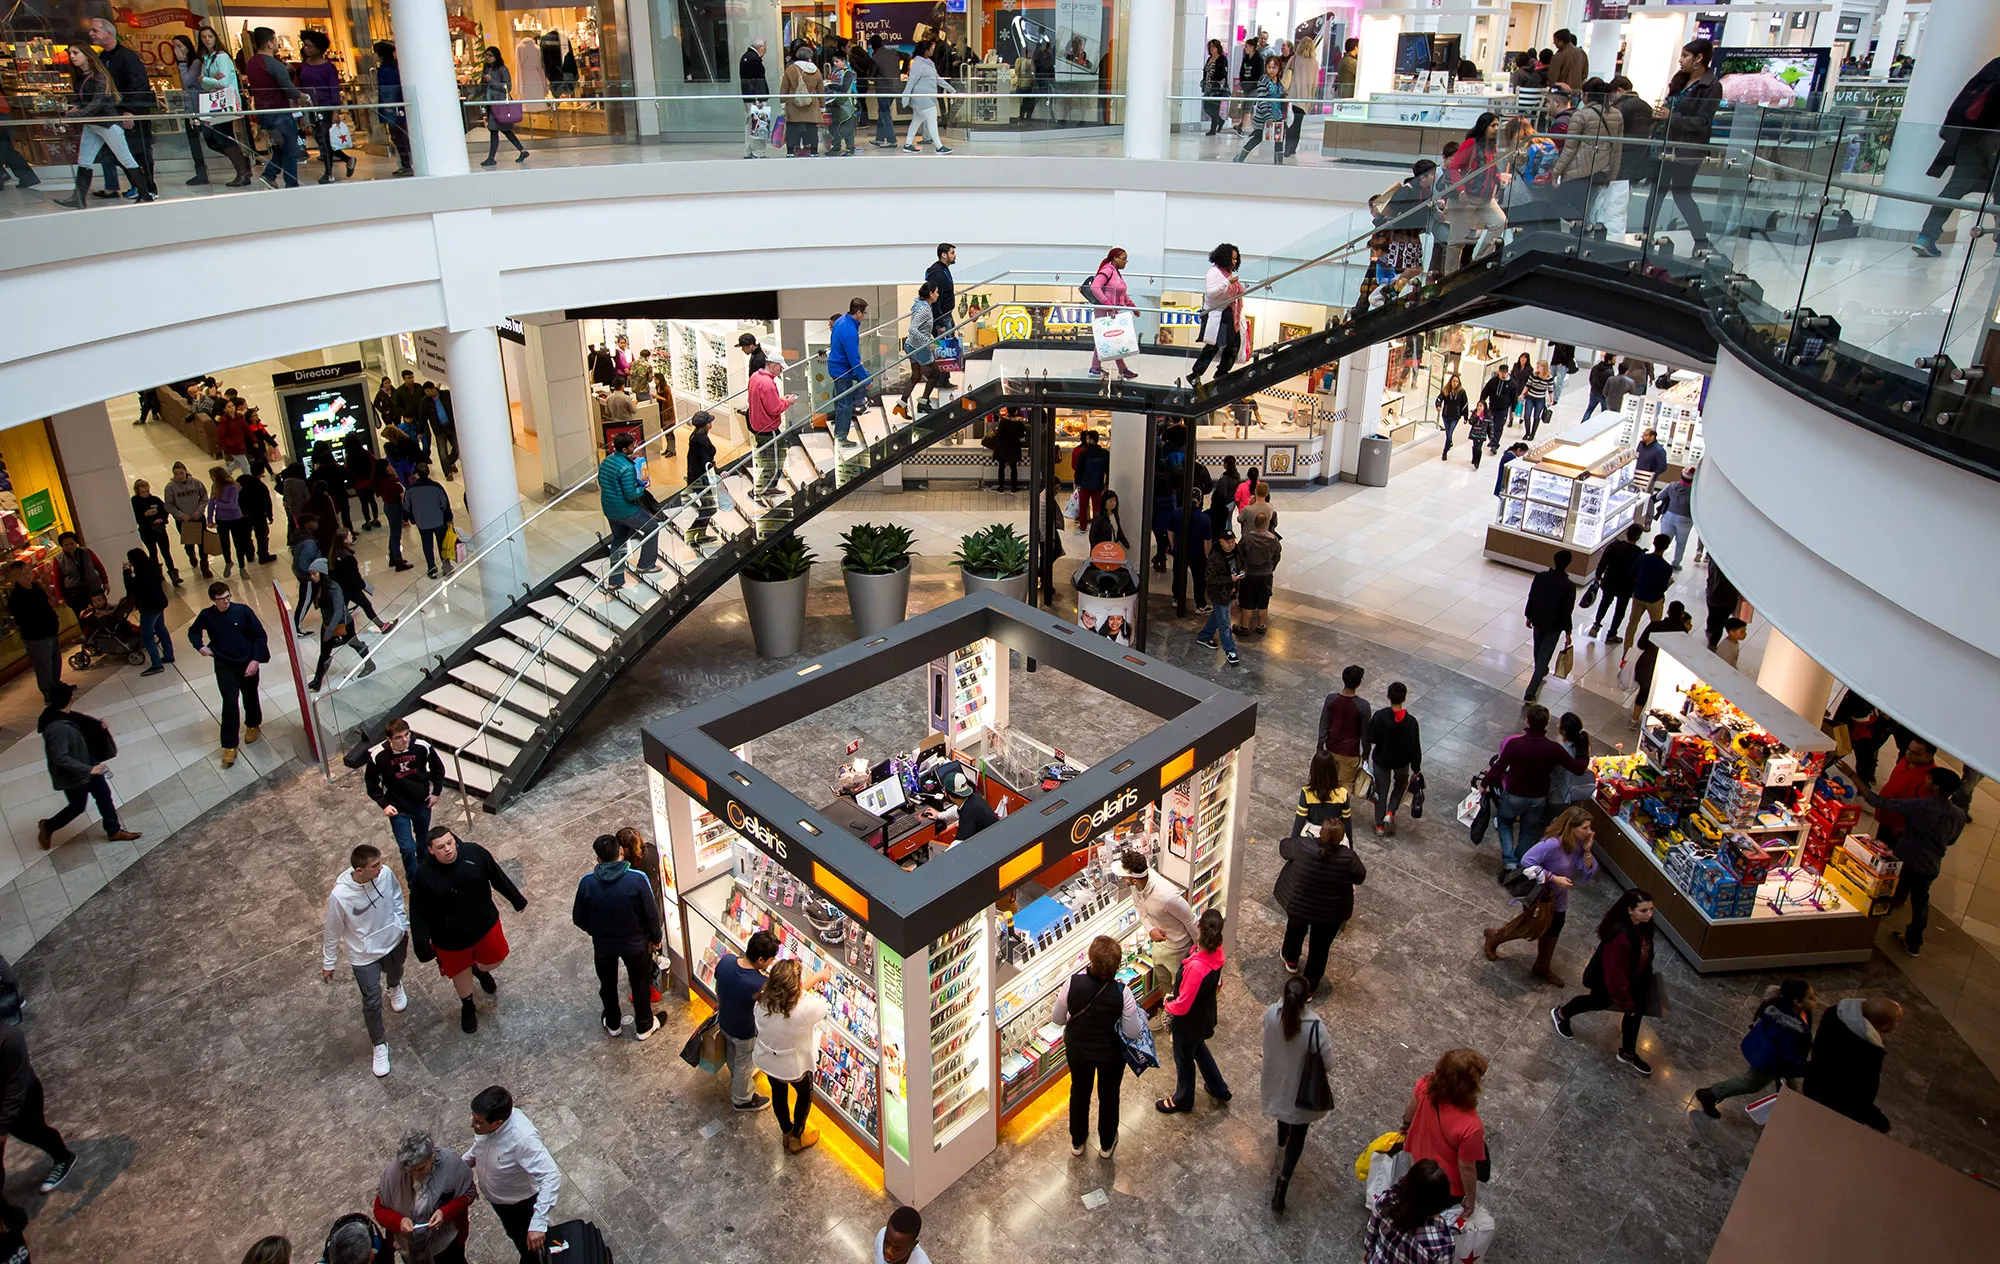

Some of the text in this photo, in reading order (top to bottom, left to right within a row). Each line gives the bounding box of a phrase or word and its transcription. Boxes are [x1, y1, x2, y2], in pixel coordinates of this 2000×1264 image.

[140, 18, 160, 27] BEST
[159, 14, 175, 24] GIFT
[855, 20, 890, 30] It's your TV.
[889, 32, 902, 42] you.
[295, 366, 340, 380] Directory
[399, 761, 410, 772] K
[884, 955, 896, 1004] DEVICE
